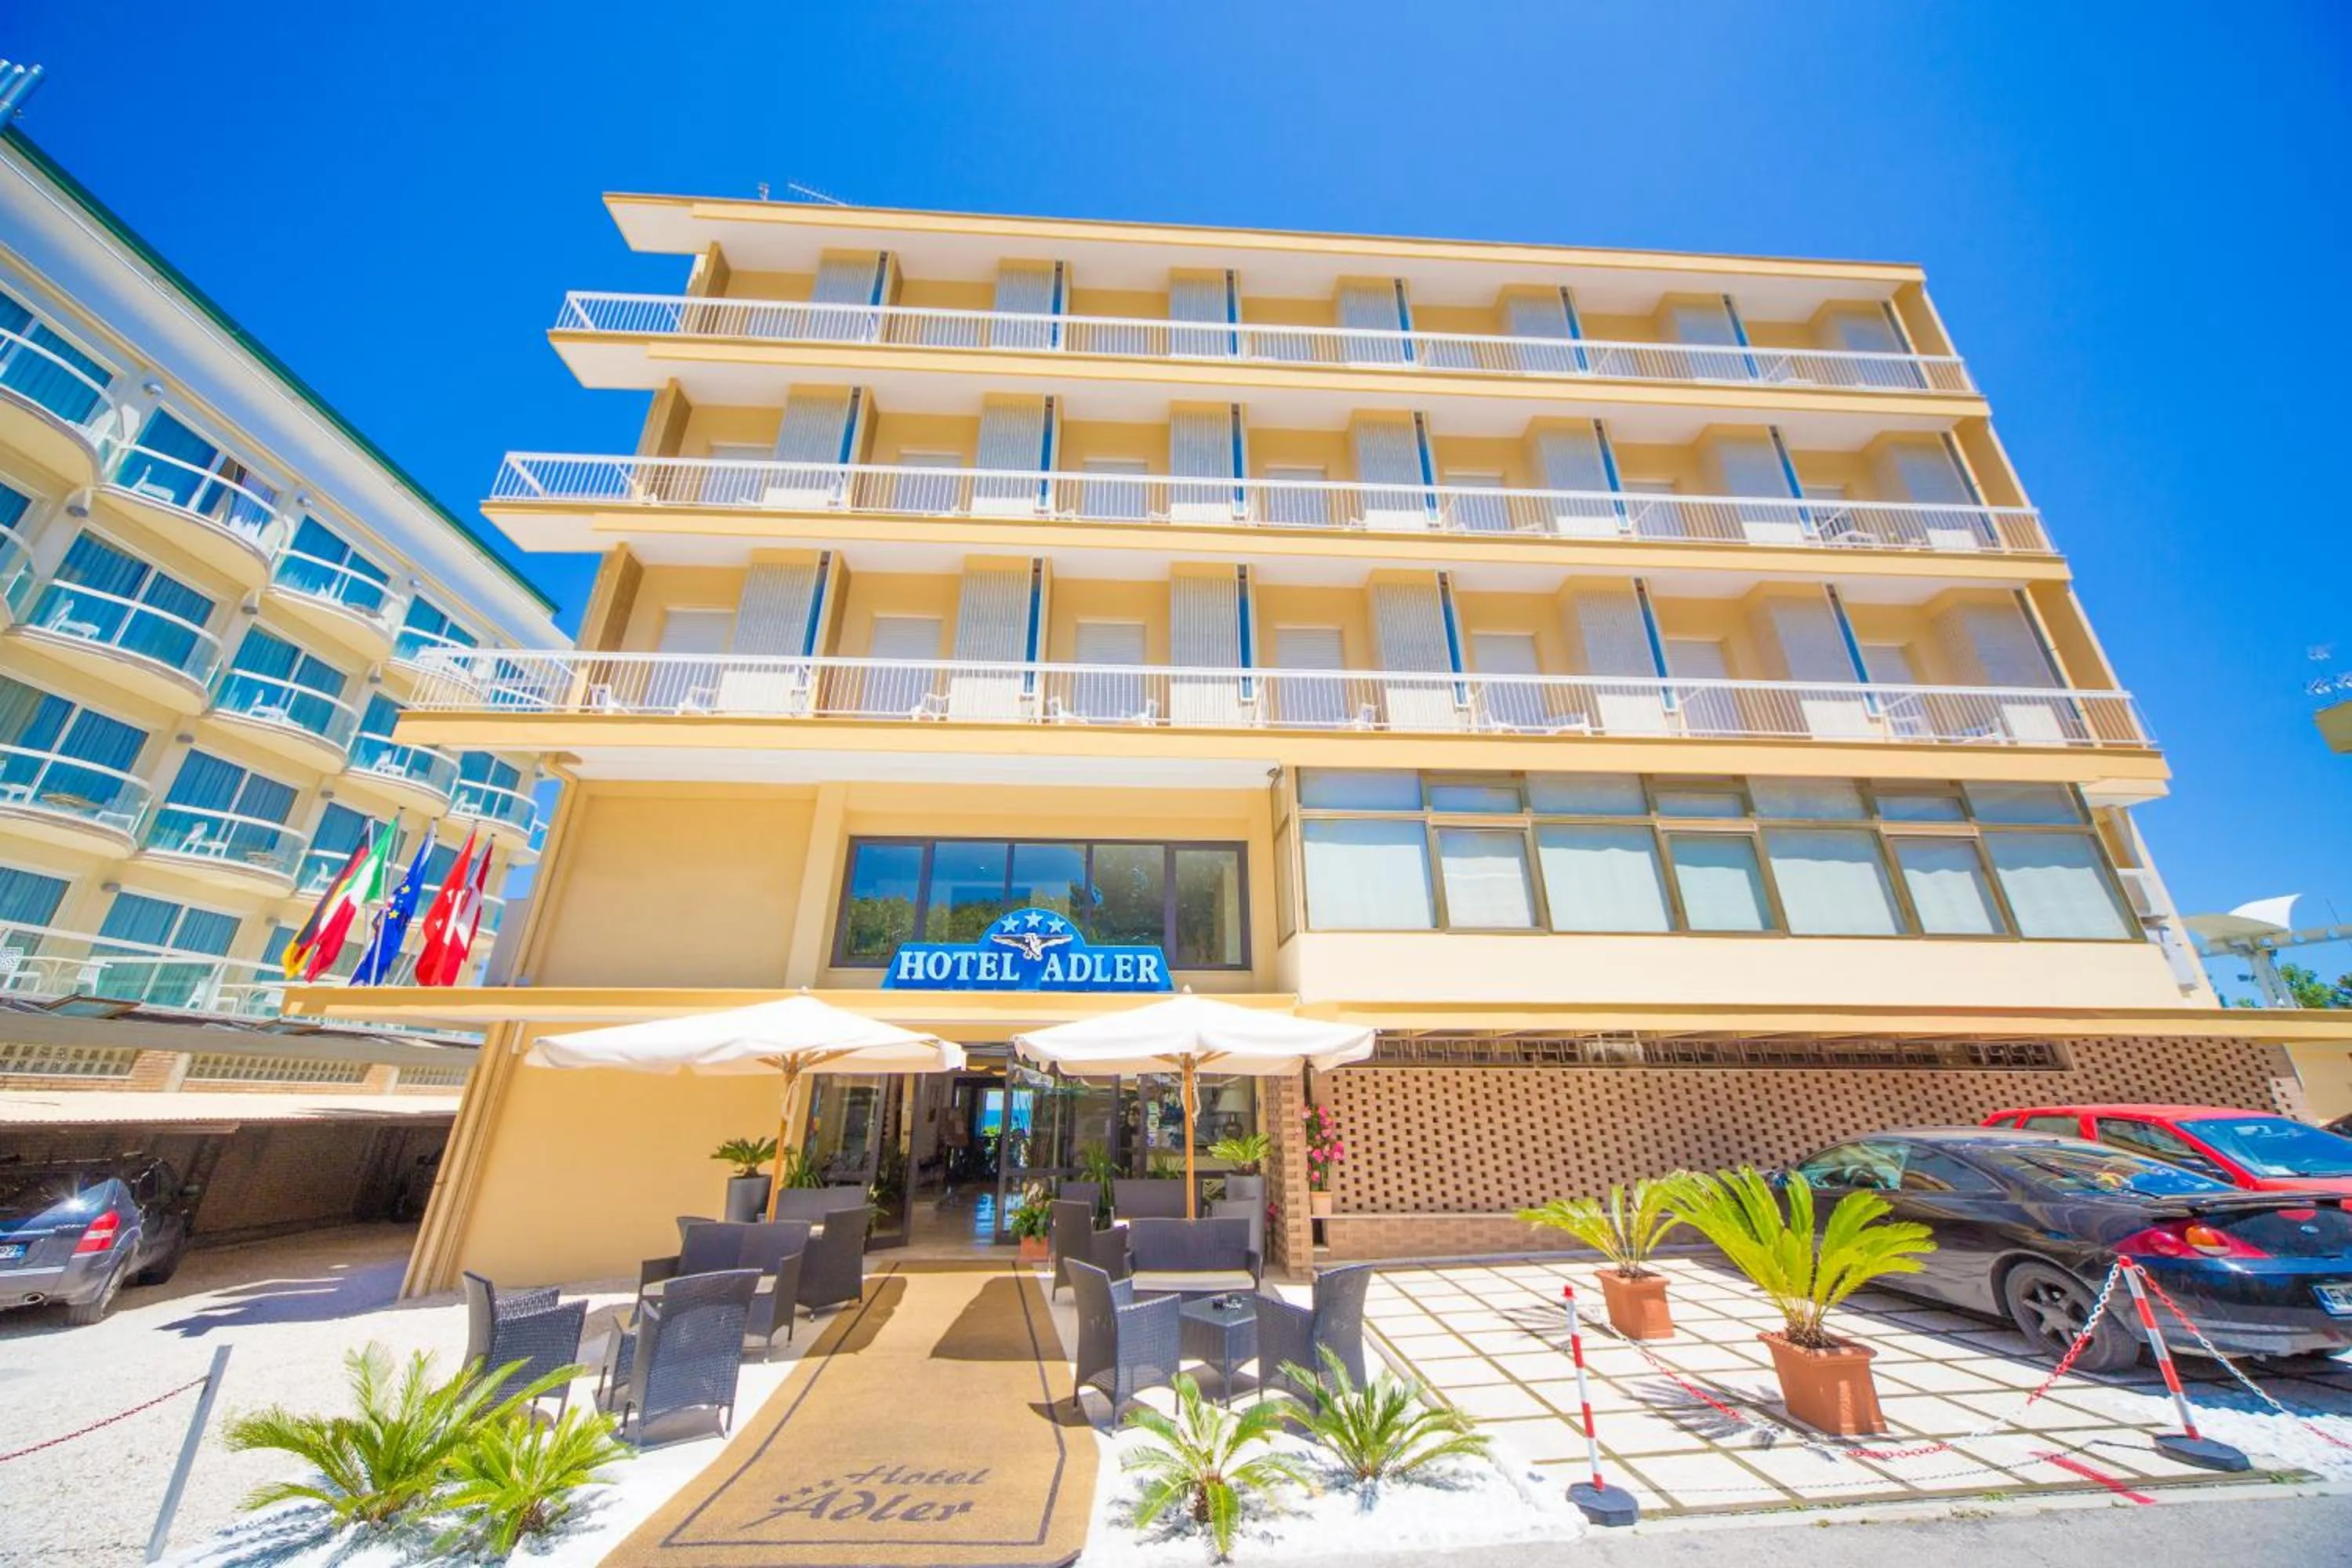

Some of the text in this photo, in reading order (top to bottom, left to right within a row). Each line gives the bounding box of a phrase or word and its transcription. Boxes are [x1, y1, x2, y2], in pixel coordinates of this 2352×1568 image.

[896, 951, 1160, 983] HOTEL ADLER
[844, 1465, 992, 1486] Hotel
[738, 1489, 975, 1530] Adler
